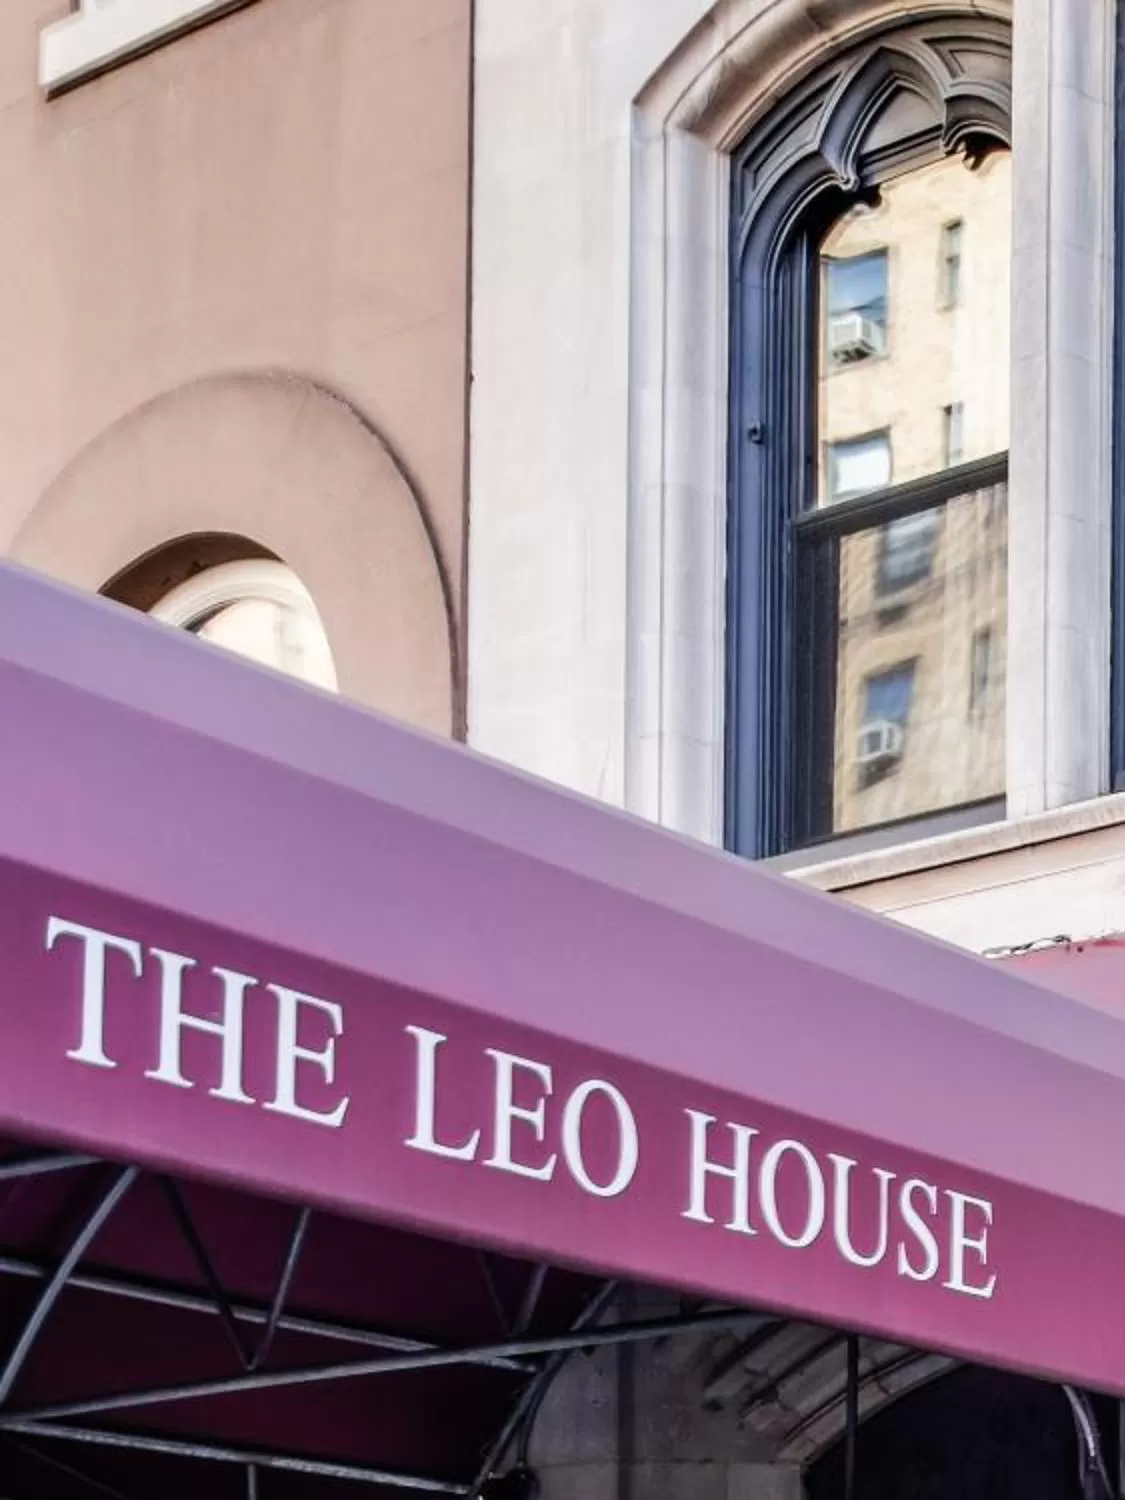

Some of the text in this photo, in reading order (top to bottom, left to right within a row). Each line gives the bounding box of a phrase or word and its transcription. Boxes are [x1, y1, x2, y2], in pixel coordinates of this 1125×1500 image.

[45, 916, 998, 1299] THE LEO HOUSE
